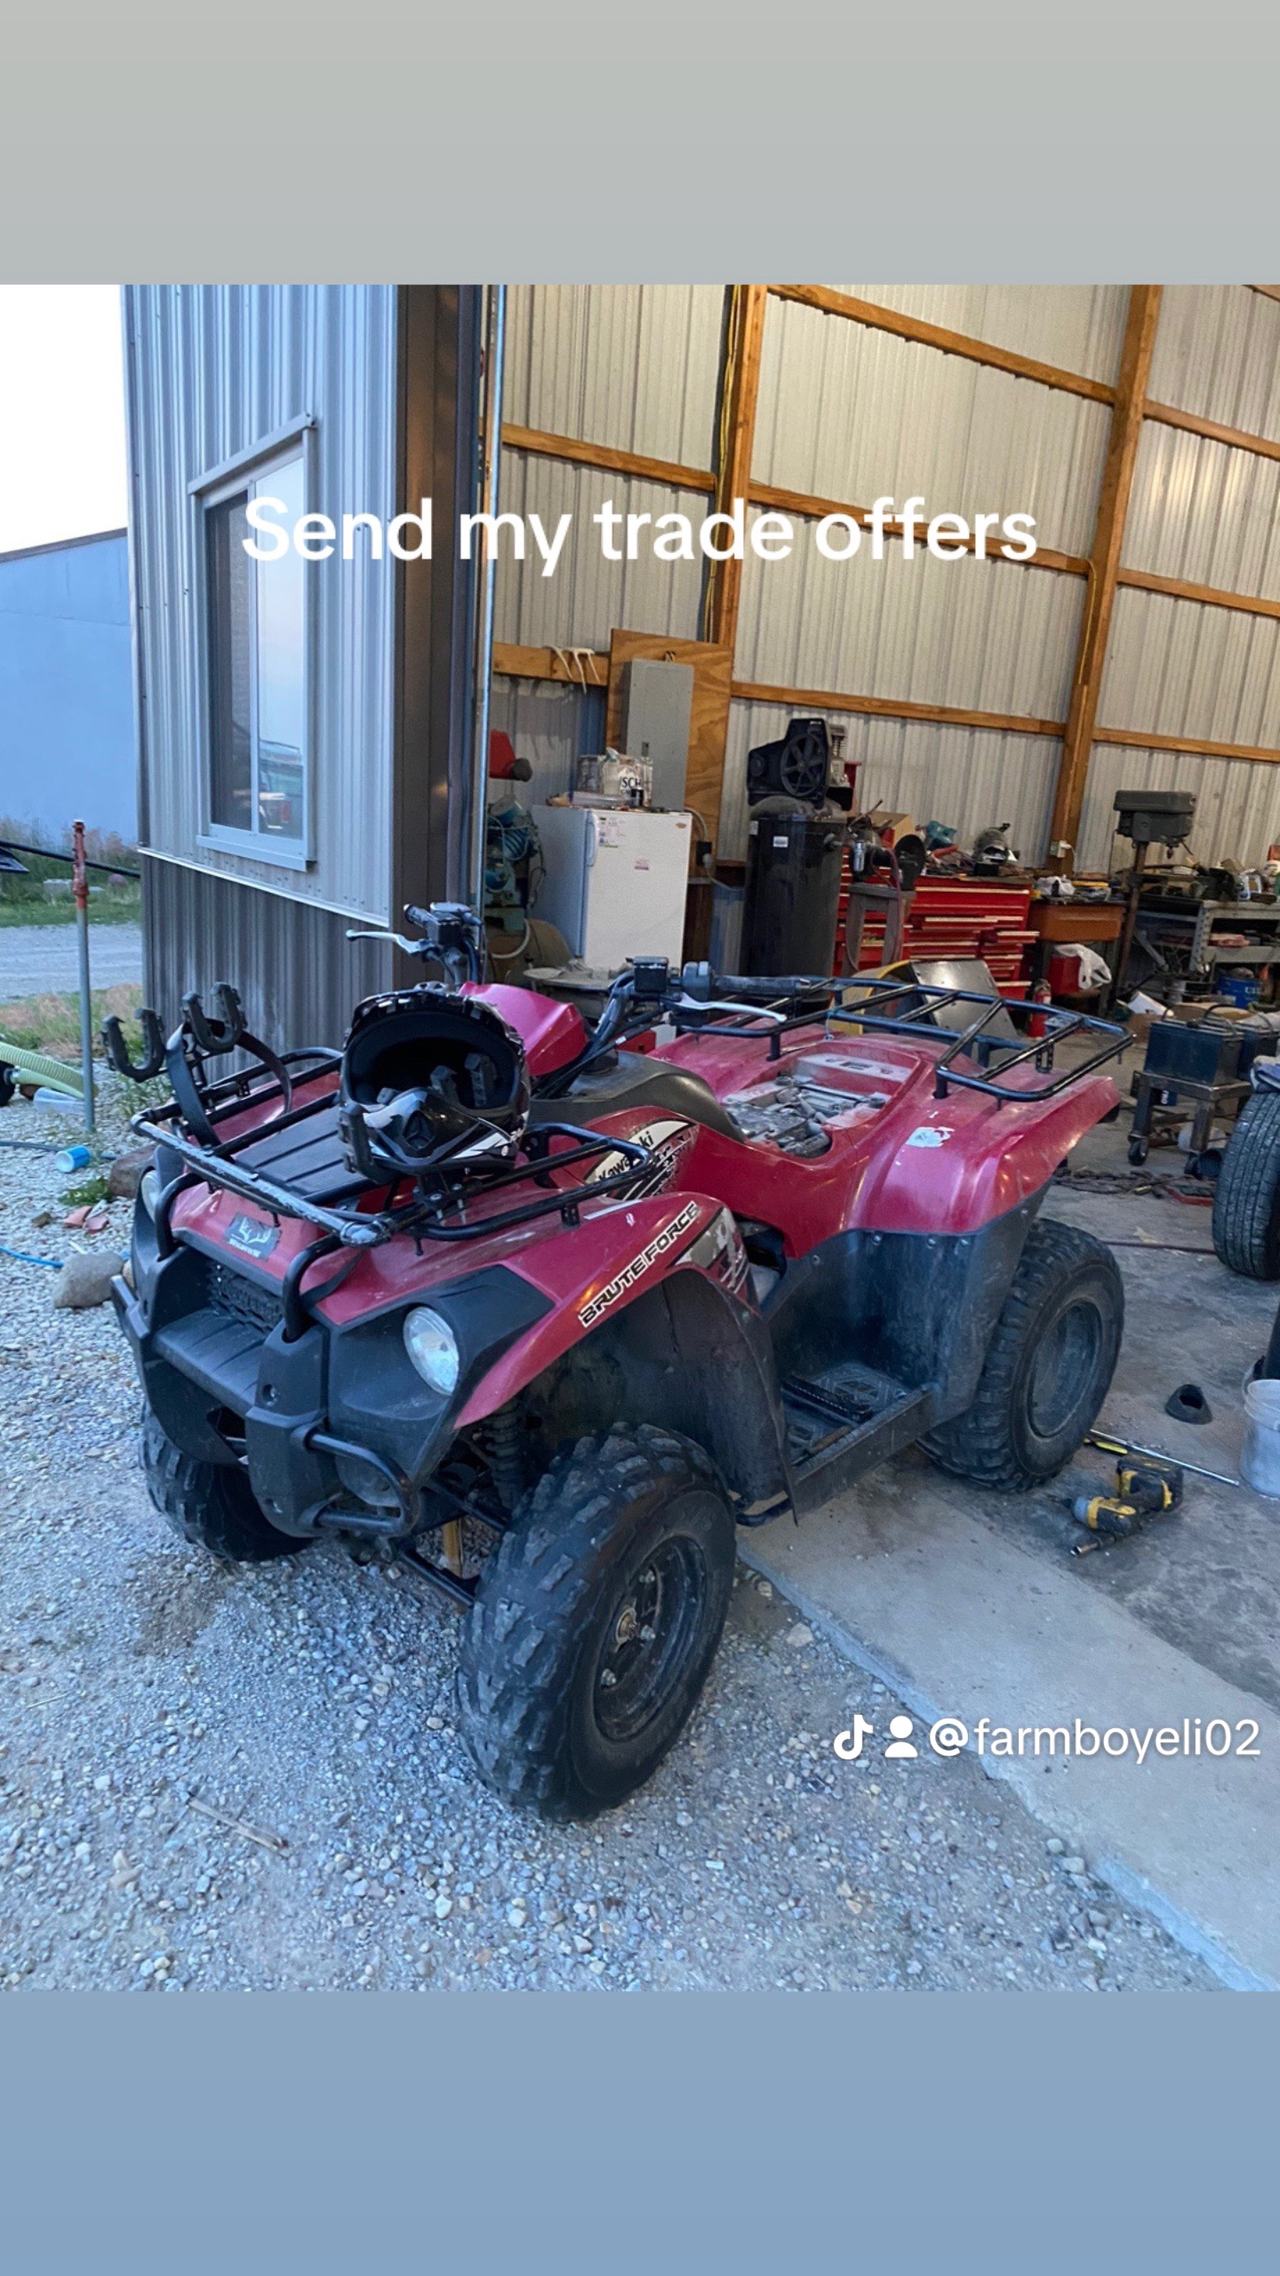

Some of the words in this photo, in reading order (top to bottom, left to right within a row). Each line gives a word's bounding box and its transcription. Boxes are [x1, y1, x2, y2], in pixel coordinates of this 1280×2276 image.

[598, 1130, 654, 1181] Kawaki
[578, 1257, 646, 1327] BRUTE
[645, 1202, 700, 1264] FORCE
